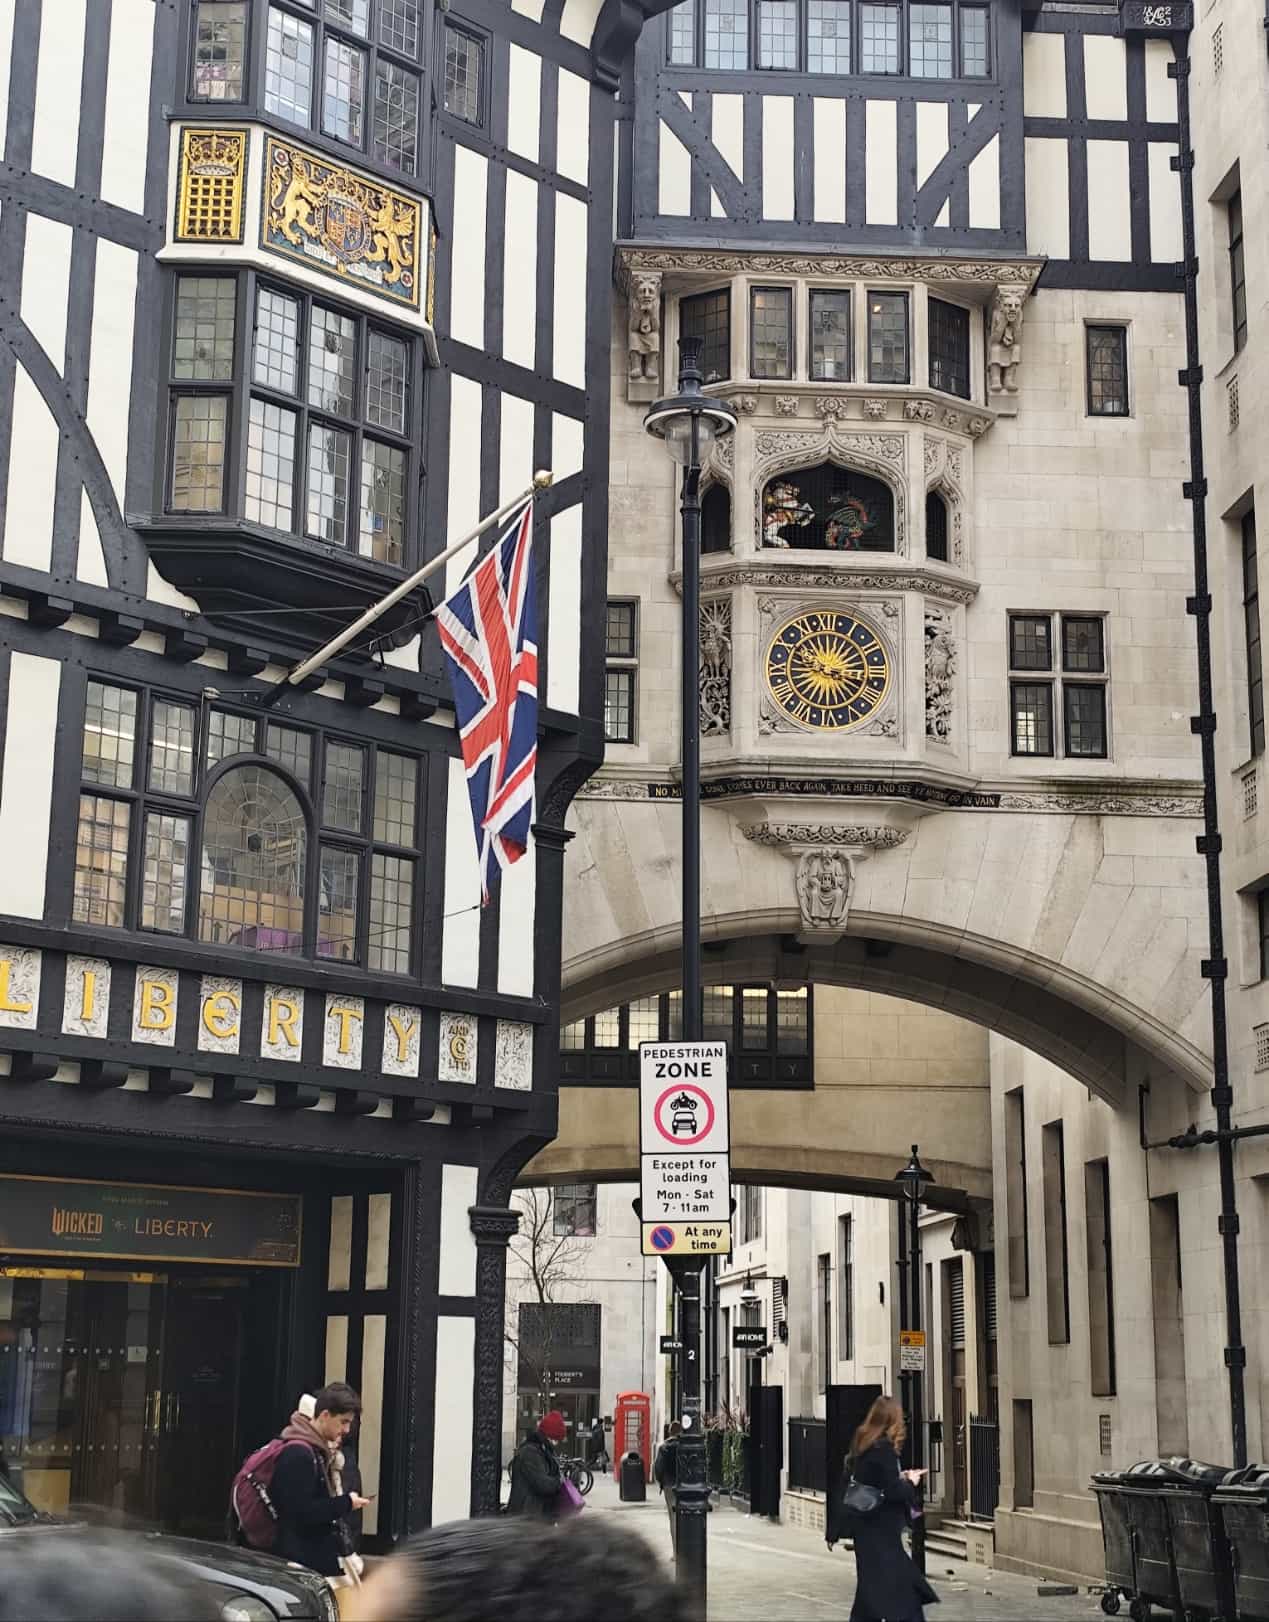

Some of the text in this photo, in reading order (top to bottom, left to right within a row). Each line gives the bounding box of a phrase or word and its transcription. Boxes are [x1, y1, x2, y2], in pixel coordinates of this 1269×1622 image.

[655, 788, 668, 797] NO
[755, 779, 777, 791] EVER
[779, 781, 801, 791] BACK
[803, 782, 826, 792] AGAIN
[832, 783, 851, 793] TAKE
[853, 784, 874, 793] HEED
[877, 784, 895, 793] AND
[975, 796, 995, 806] VAIN
[644, 1048, 723, 1059] PEDESTRIAN
[656, 1062, 712, 1078] ZONE
[653, 1160, 716, 1170] Except for
[662, 1172, 708, 1183] loading
[657, 1190, 681, 1199] Mon
[694, 1189, 714, 1199] Sat
[662, 1203, 670, 1212] 7
[52, 1207, 104, 1237] WICKED
[685, 1227, 722, 1238] At any
[691, 1240, 717, 1249] time
[687, 1350, 695, 1360] 2
